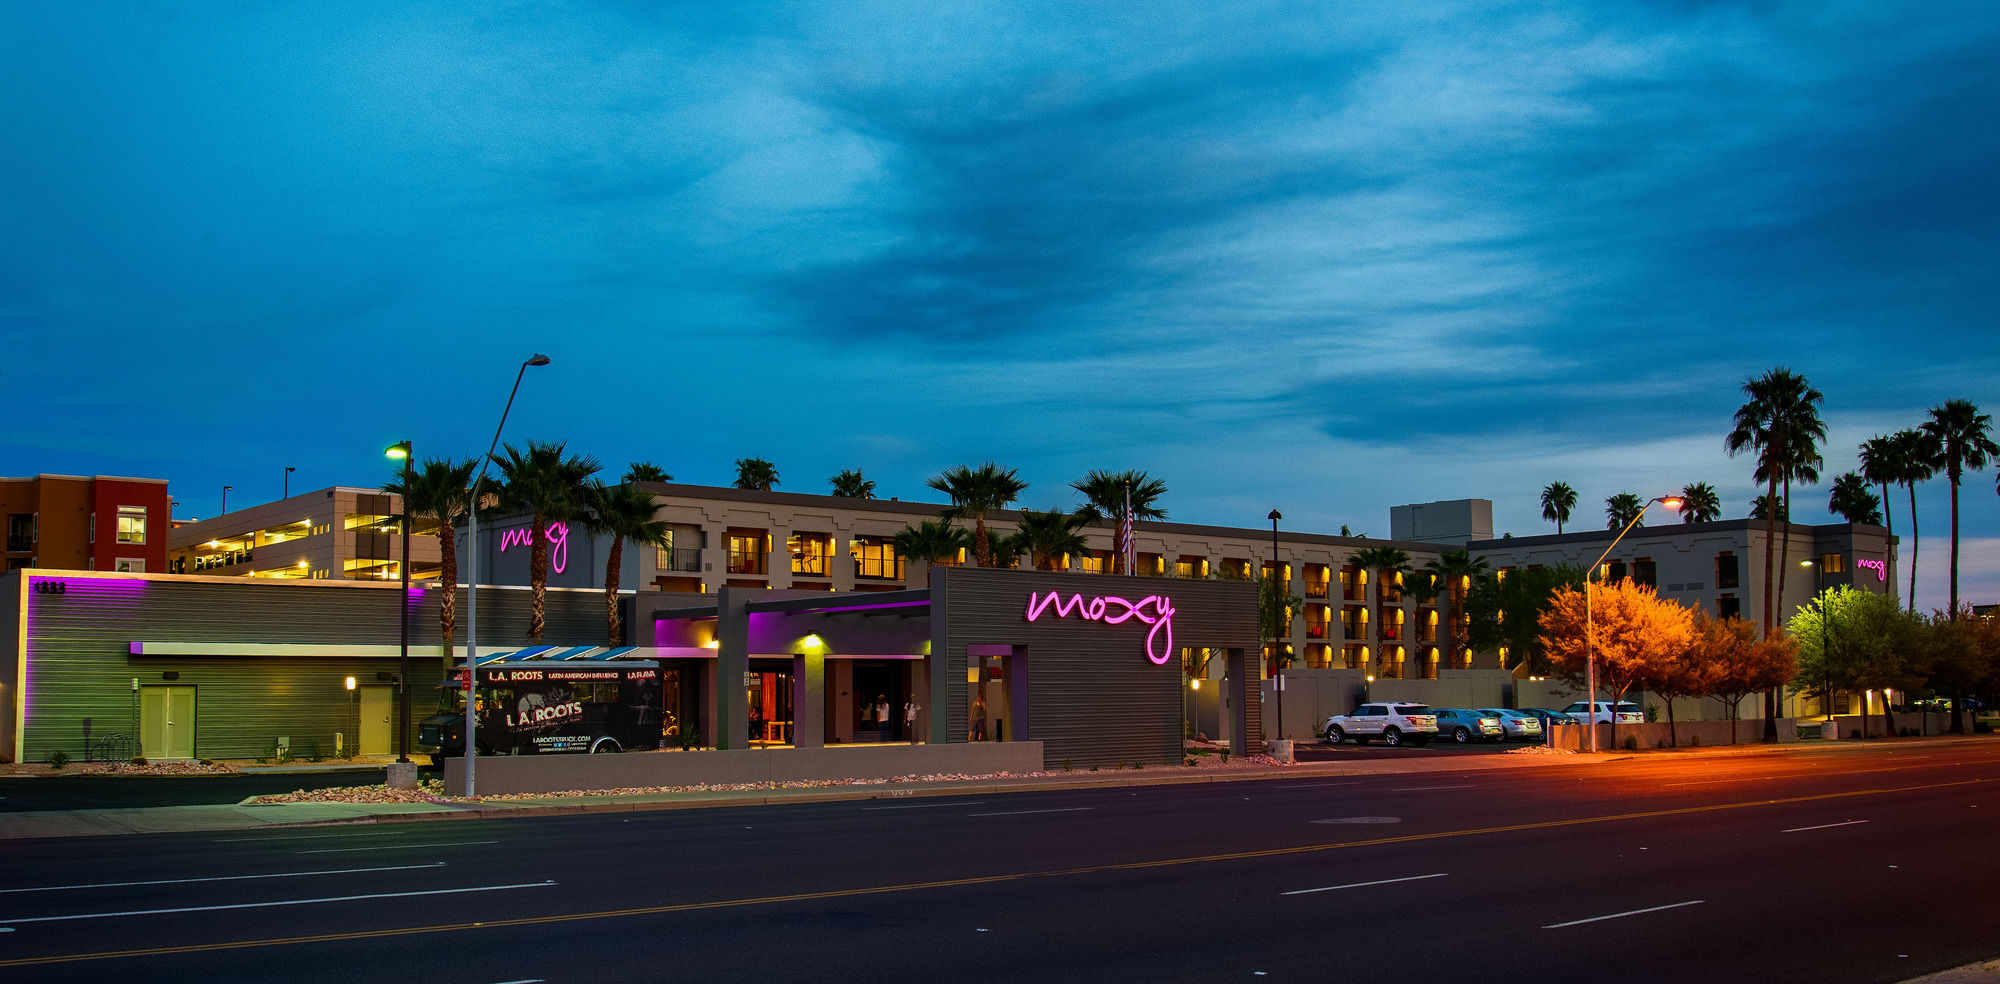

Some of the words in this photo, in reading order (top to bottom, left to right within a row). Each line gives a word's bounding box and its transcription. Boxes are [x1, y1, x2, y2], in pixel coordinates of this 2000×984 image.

[1857, 558, 1885, 581] moxy
[1026, 590, 1176, 665] moxy
[489, 671, 508, 682] L.A.
[511, 671, 543, 681] ROOTS
[535, 701, 583, 721] ROOTS
